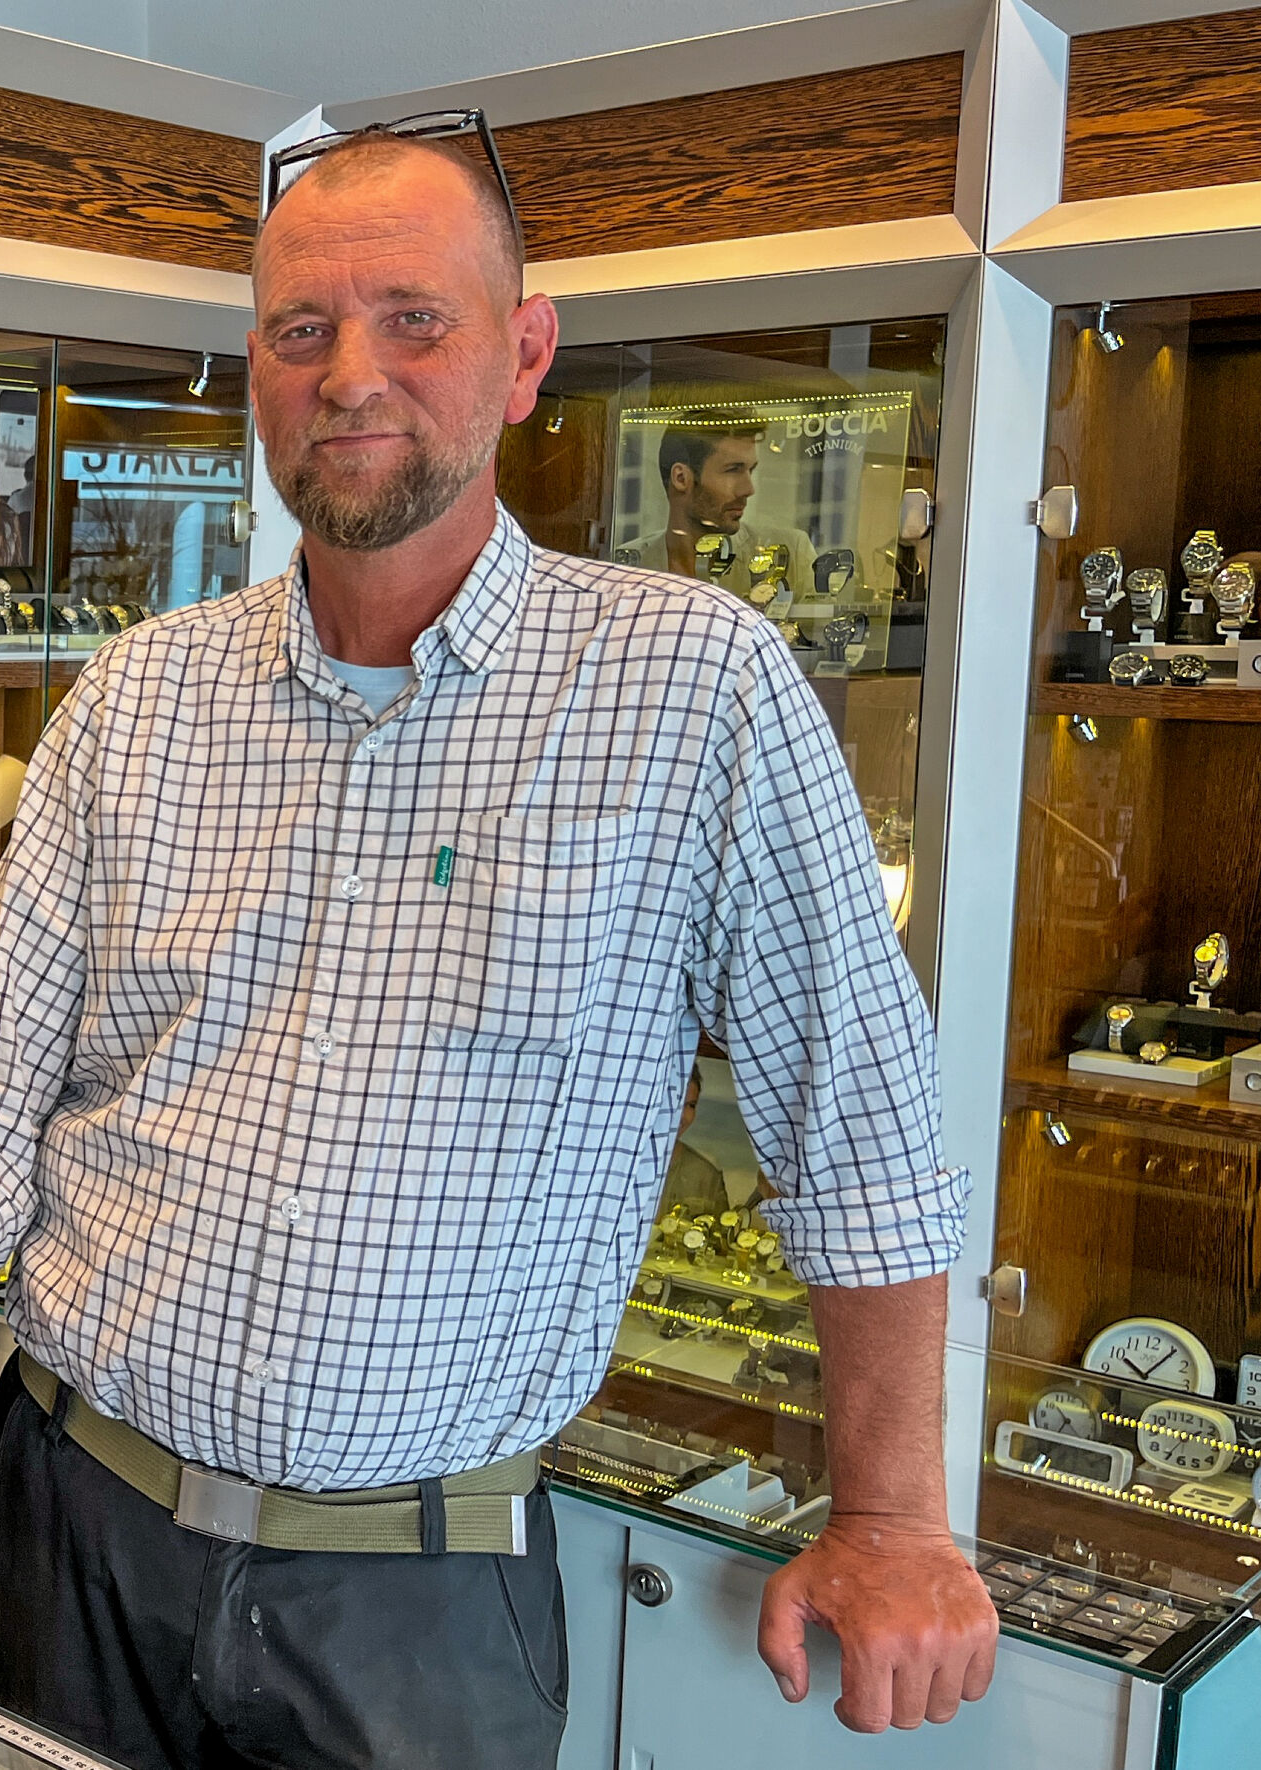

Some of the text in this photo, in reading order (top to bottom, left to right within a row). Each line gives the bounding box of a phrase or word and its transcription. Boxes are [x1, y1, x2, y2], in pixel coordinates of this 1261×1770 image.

[786, 409, 888, 438] BOCCIA
[805, 439, 864, 457] TITANIUM
[1127, 1336, 1140, 1352] 11
[1145, 1335, 1161, 1351] 12
[1110, 1345, 1126, 1361] 10
[1101, 1361, 1110, 1374] 9
[1178, 1360, 1189, 1374] 2
[1246, 1386, 1257, 1396] 9
[1150, 1415, 1167, 1426] 10
[1166, 1411, 1178, 1422] 11
[1180, 1412, 1195, 1424] 12
[1198, 1418, 1204, 1427] 1
[1207, 1426, 1216, 1437] 2
[1149, 1441, 1160, 1452] 8
[1163, 1451, 1173, 1461] 7
[1176, 1456, 1186, 1466] 6
[1204, 1455, 1215, 1466] 4
[1190, 1458, 1201, 1469] 5
